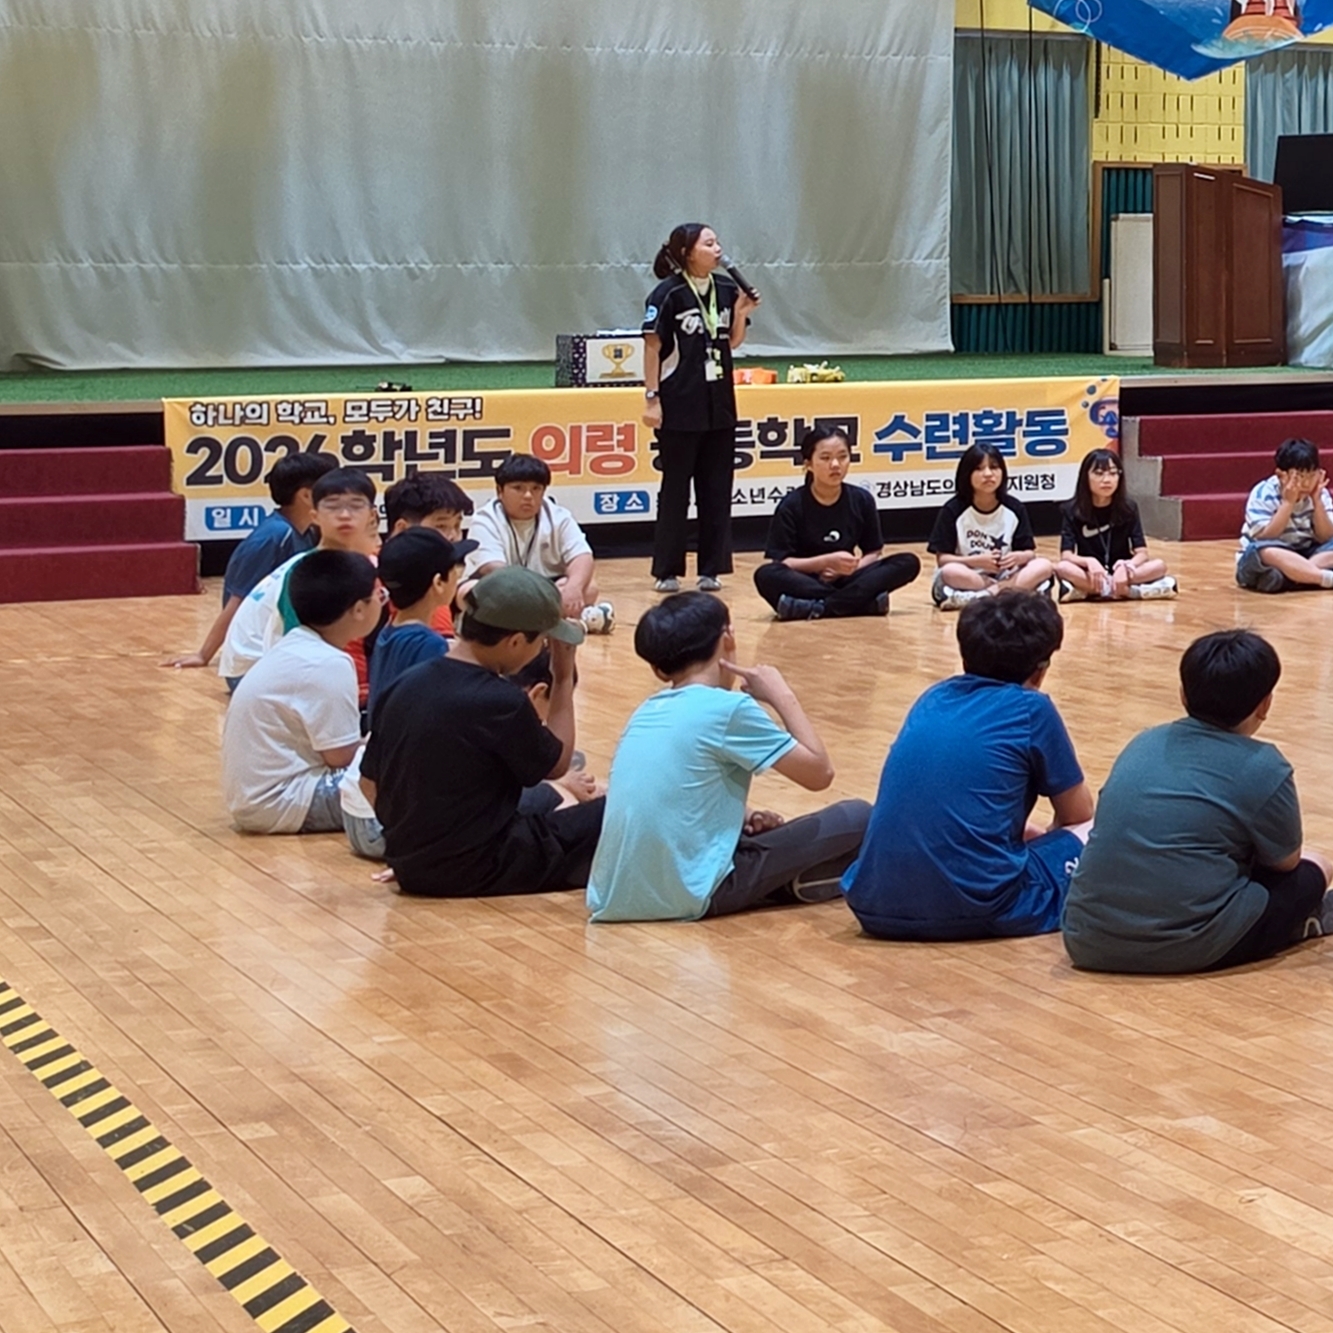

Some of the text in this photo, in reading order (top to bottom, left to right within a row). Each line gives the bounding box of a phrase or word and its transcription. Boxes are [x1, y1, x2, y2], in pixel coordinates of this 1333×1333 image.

[190, 397, 482, 426] 하나의 학교, 모두가 친구!
[531, 424, 637, 475] 의령
[873, 409, 1069, 462] 수련활동
